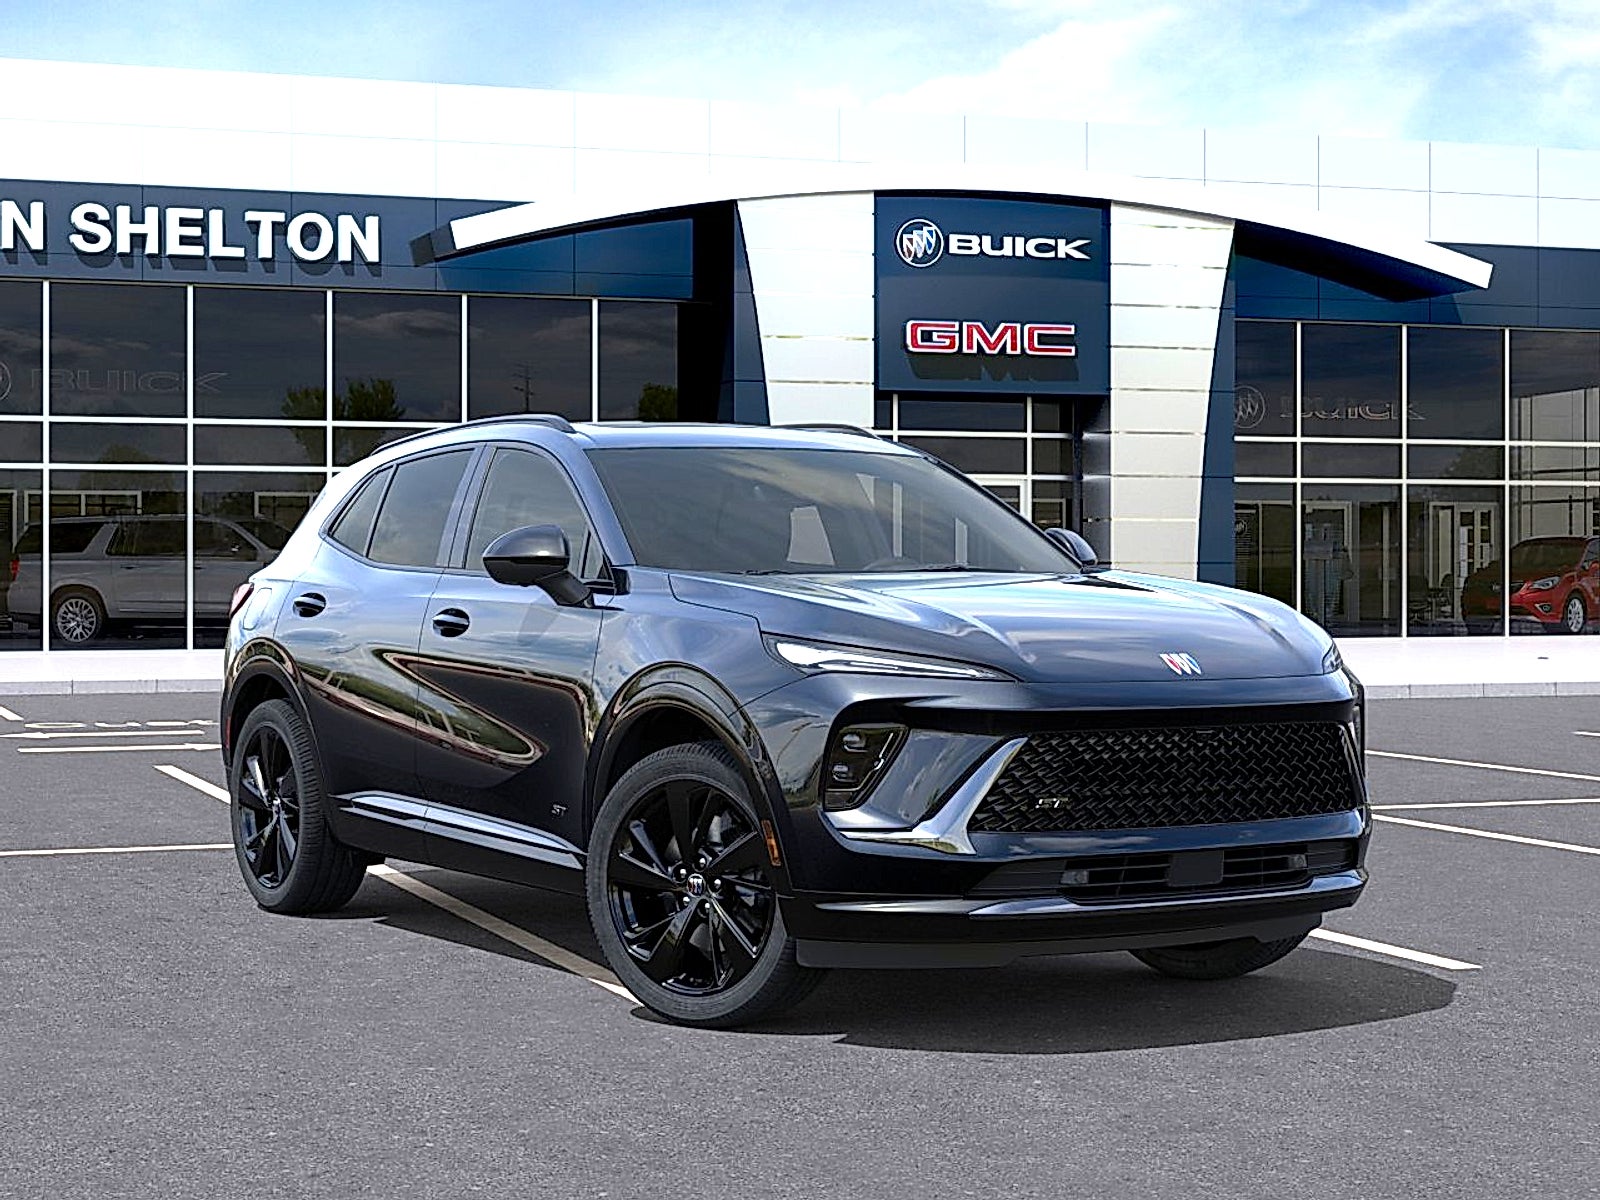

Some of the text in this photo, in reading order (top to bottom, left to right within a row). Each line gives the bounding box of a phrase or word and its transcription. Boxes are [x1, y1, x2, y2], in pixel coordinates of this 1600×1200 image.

[68, 202, 381, 264] SHELTON
[948, 233, 1092, 260] BUICK
[905, 319, 1077, 357] GMC
[31, 368, 229, 393] BUICK
